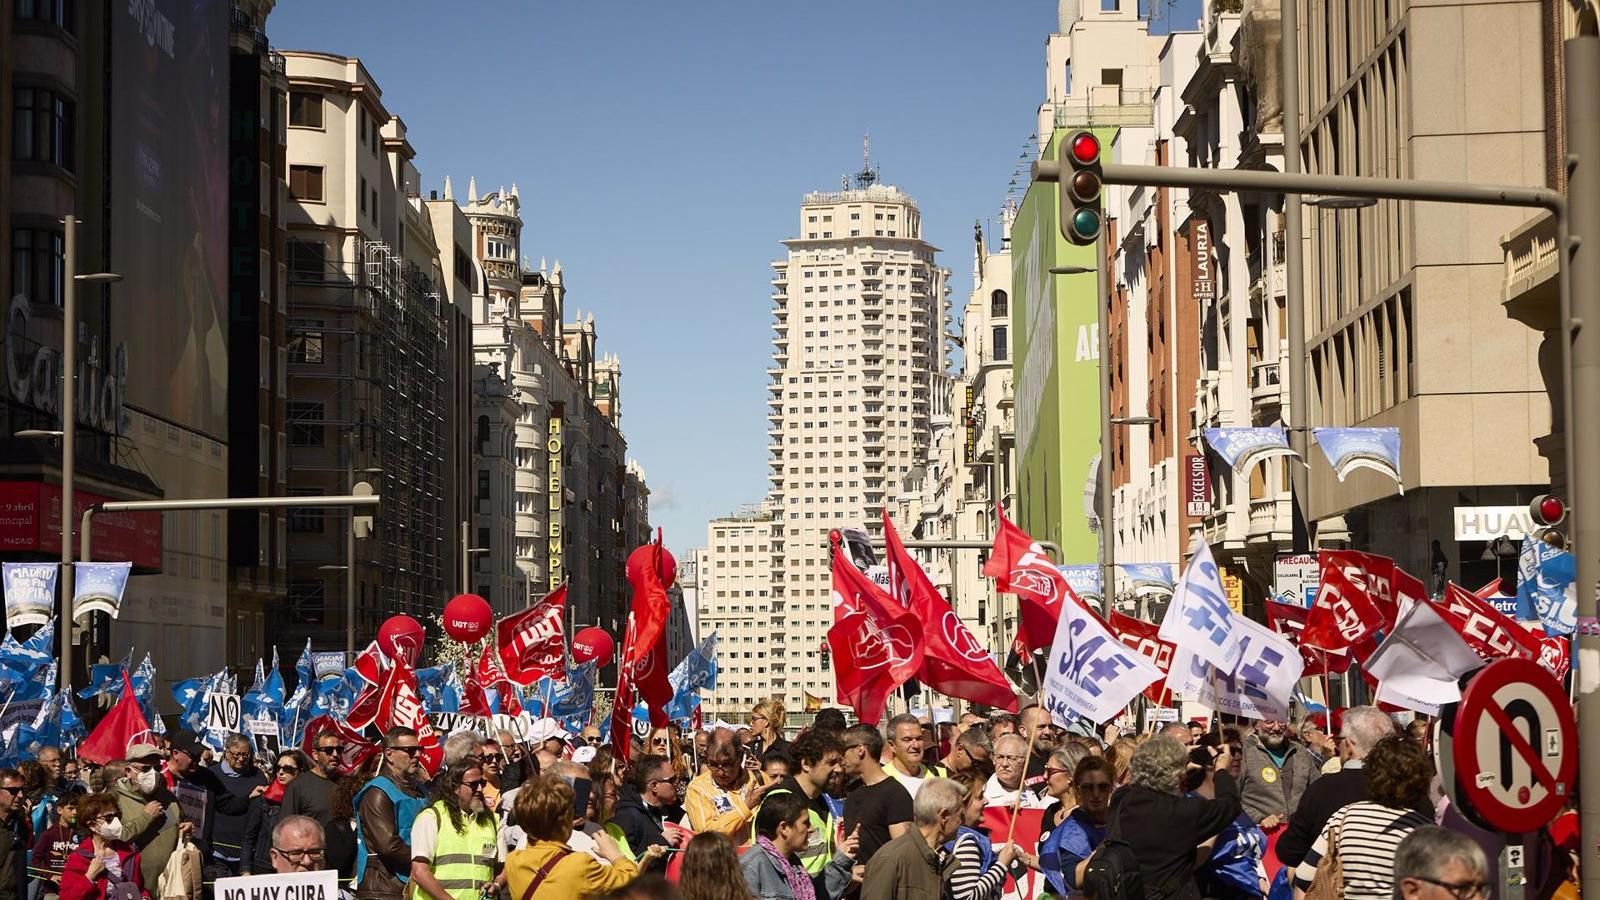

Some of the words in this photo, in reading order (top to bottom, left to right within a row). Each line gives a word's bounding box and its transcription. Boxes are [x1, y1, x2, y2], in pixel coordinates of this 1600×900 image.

[1197, 223, 1208, 279] LAURIA
[548, 417, 562, 511] HOTEL
[1192, 457, 1204, 501] EXCELSIOR
[1279, 556, 1319, 565] PRECAUCI
[452, 620, 468, 629] UGT
[573, 642, 584, 651] UGT
[210, 695, 239, 730] NO
[225, 889, 246, 900] NO
[251, 886, 281, 900] HAY
[286, 884, 325, 900] CURA
